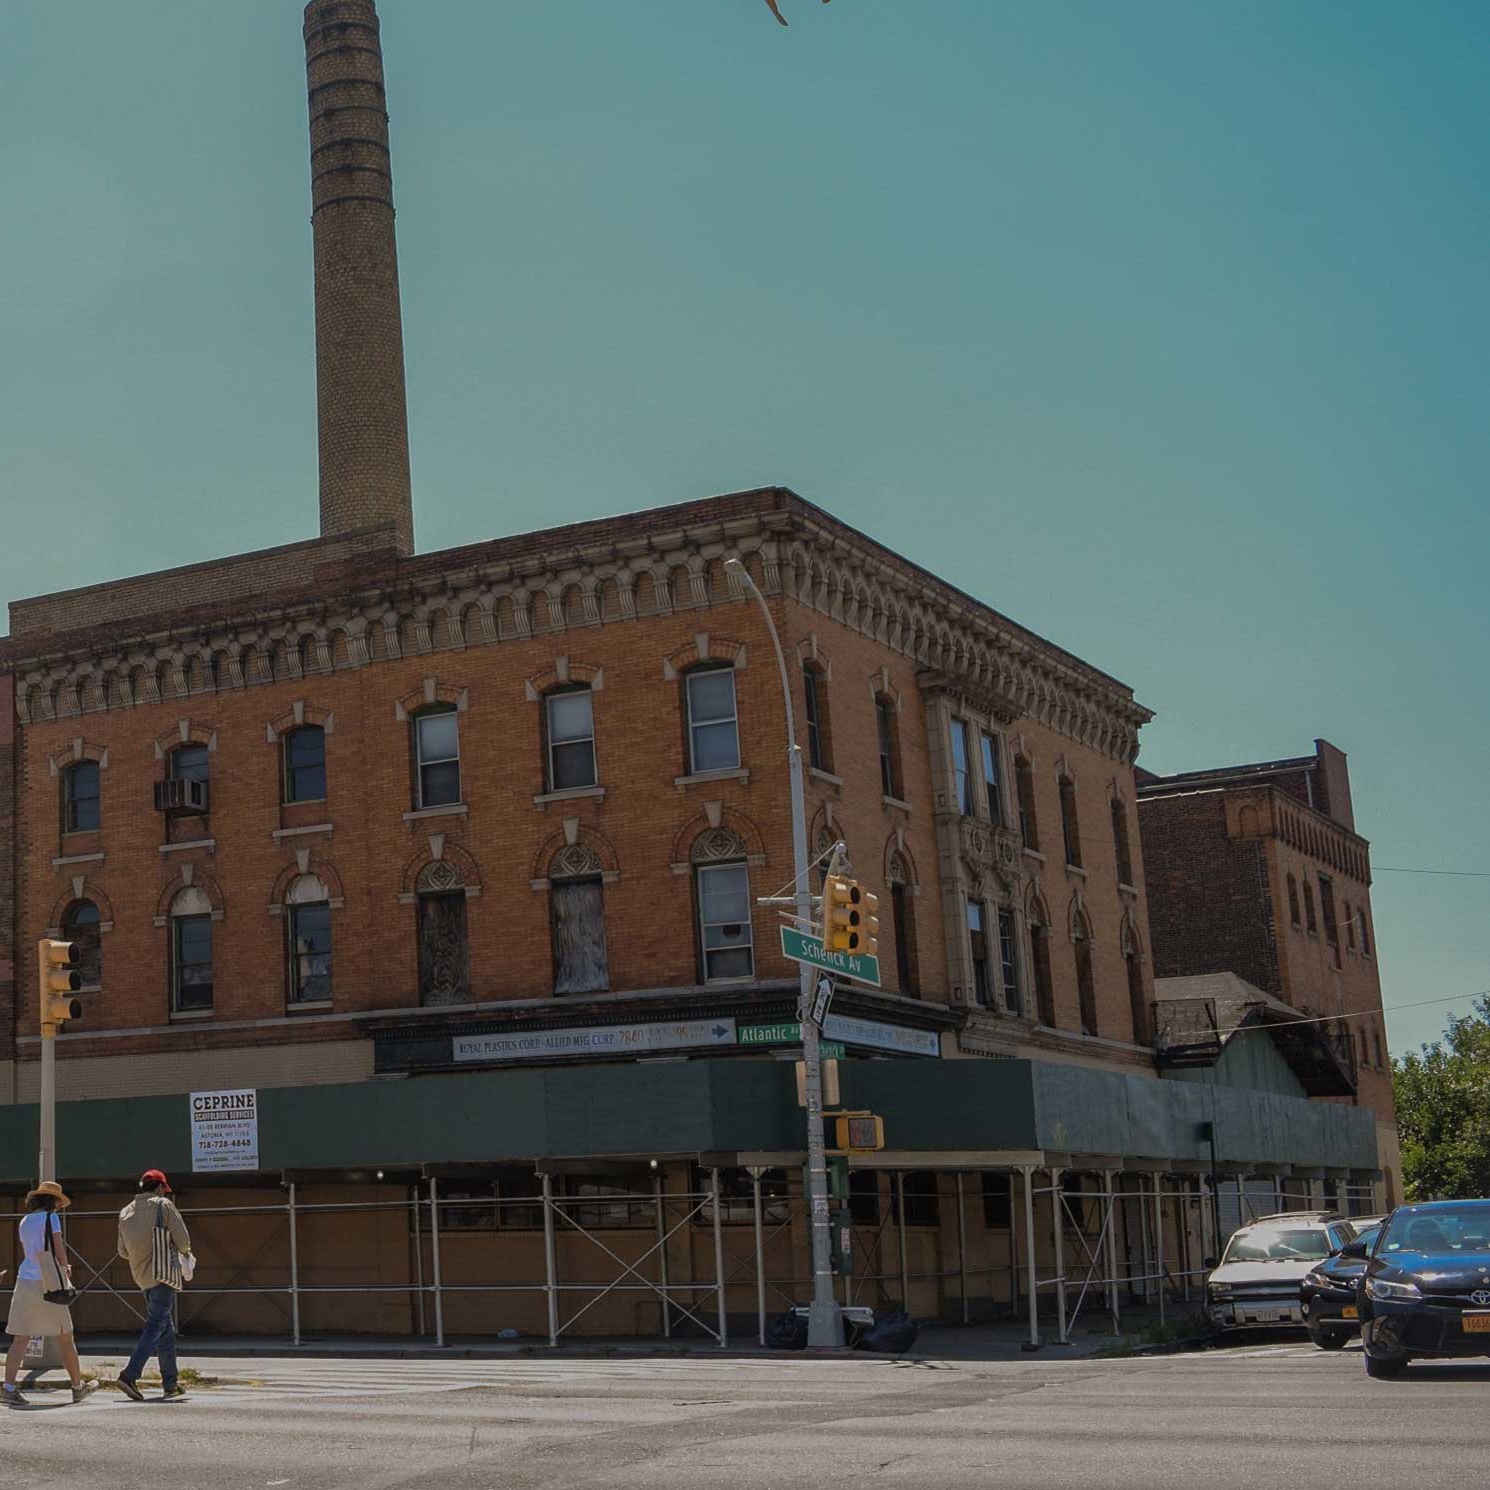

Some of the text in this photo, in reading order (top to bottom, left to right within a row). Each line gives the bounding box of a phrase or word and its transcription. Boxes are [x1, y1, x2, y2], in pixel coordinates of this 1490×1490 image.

[801, 940, 861, 972] Schenck Av
[742, 1027, 787, 1041] Atlantic
[460, 1042, 482, 1053] ROYAL
[484, 1039, 517, 1052] PLASTICS
[193, 1094, 254, 1110] CEPRINE
[230, 1110, 254, 1119] SERVICES
